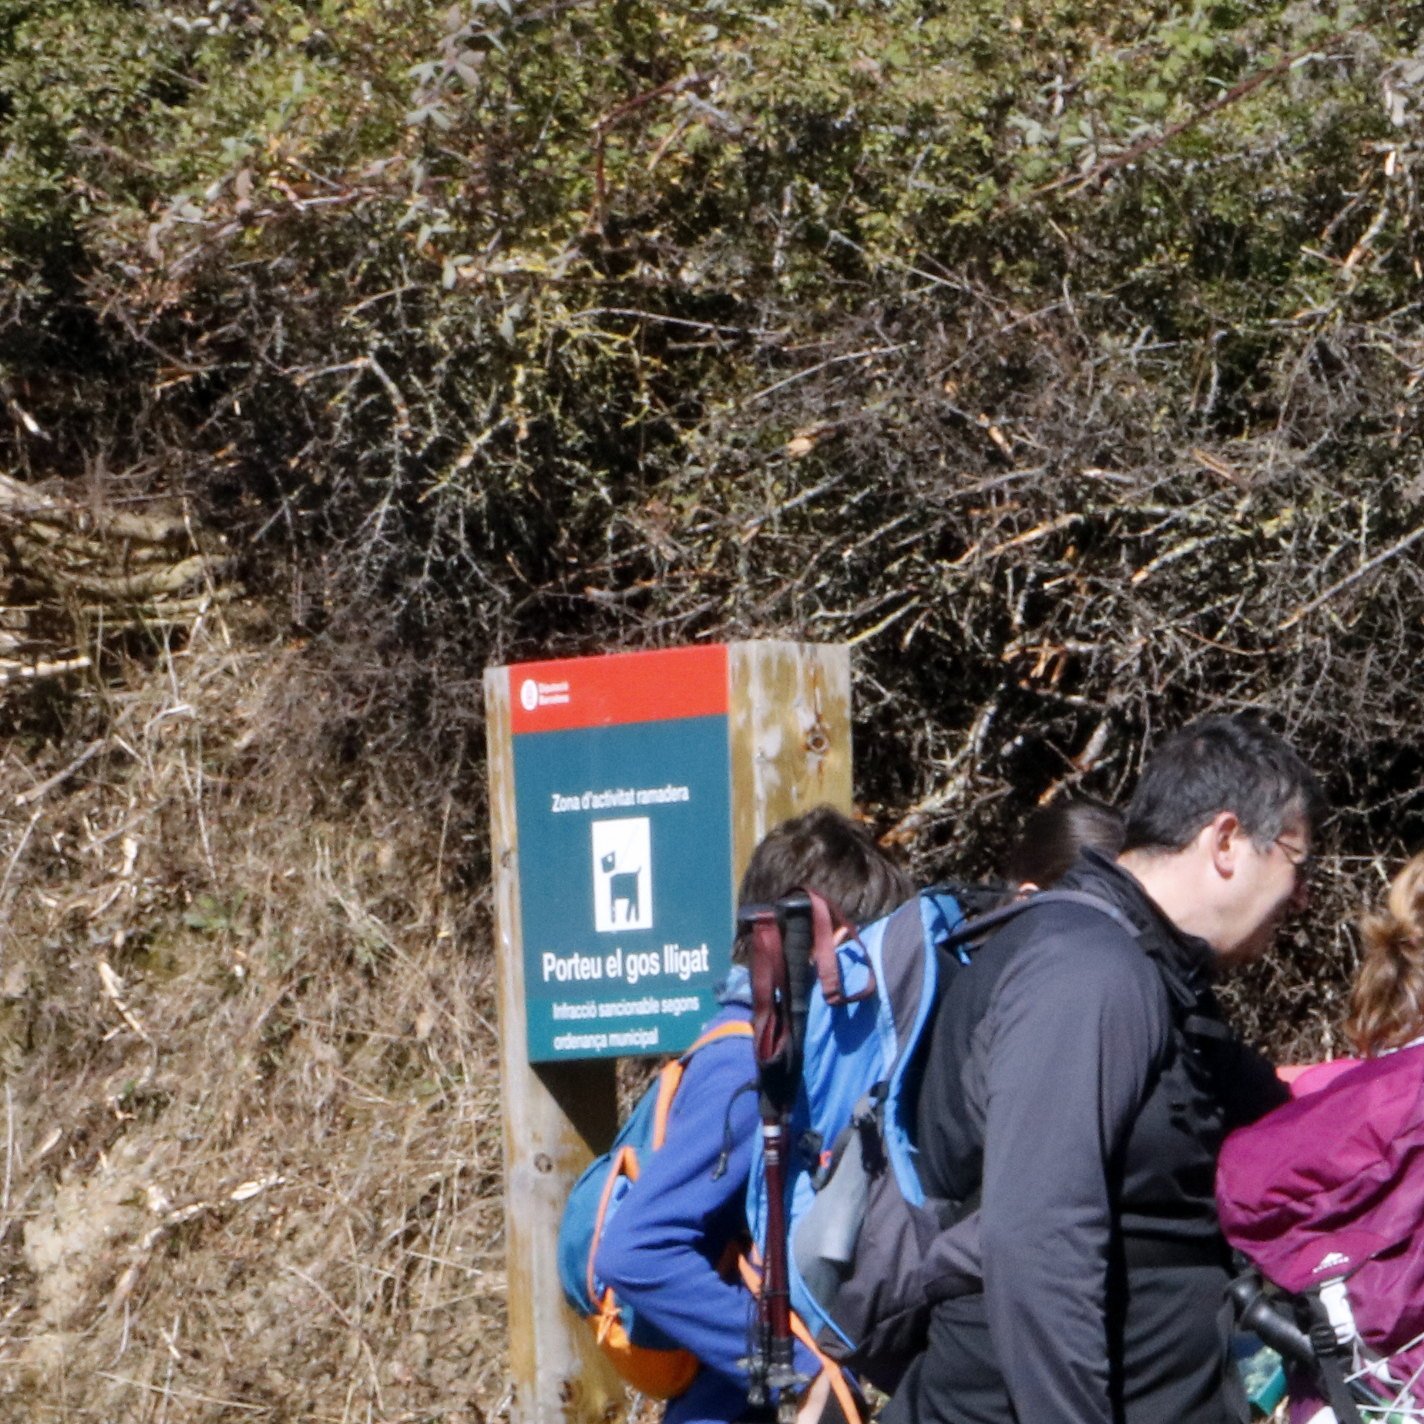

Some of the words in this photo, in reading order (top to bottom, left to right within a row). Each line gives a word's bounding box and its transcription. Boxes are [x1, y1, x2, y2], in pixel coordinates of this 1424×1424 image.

[551, 793, 581, 812] Zona
[582, 788, 635, 810] d'activitat
[636, 784, 690, 805] ramadera
[542, 952, 602, 982] Porteu
[606, 947, 622, 978] el
[626, 951, 660, 984] gos
[663, 943, 709, 981] lligat
[553, 1000, 597, 1020] Infracció
[598, 996, 660, 1018] sancionable
[661, 996, 699, 1016] segons
[554, 1032, 608, 1051] ordenança
[608, 1026, 659, 1048] municipal
